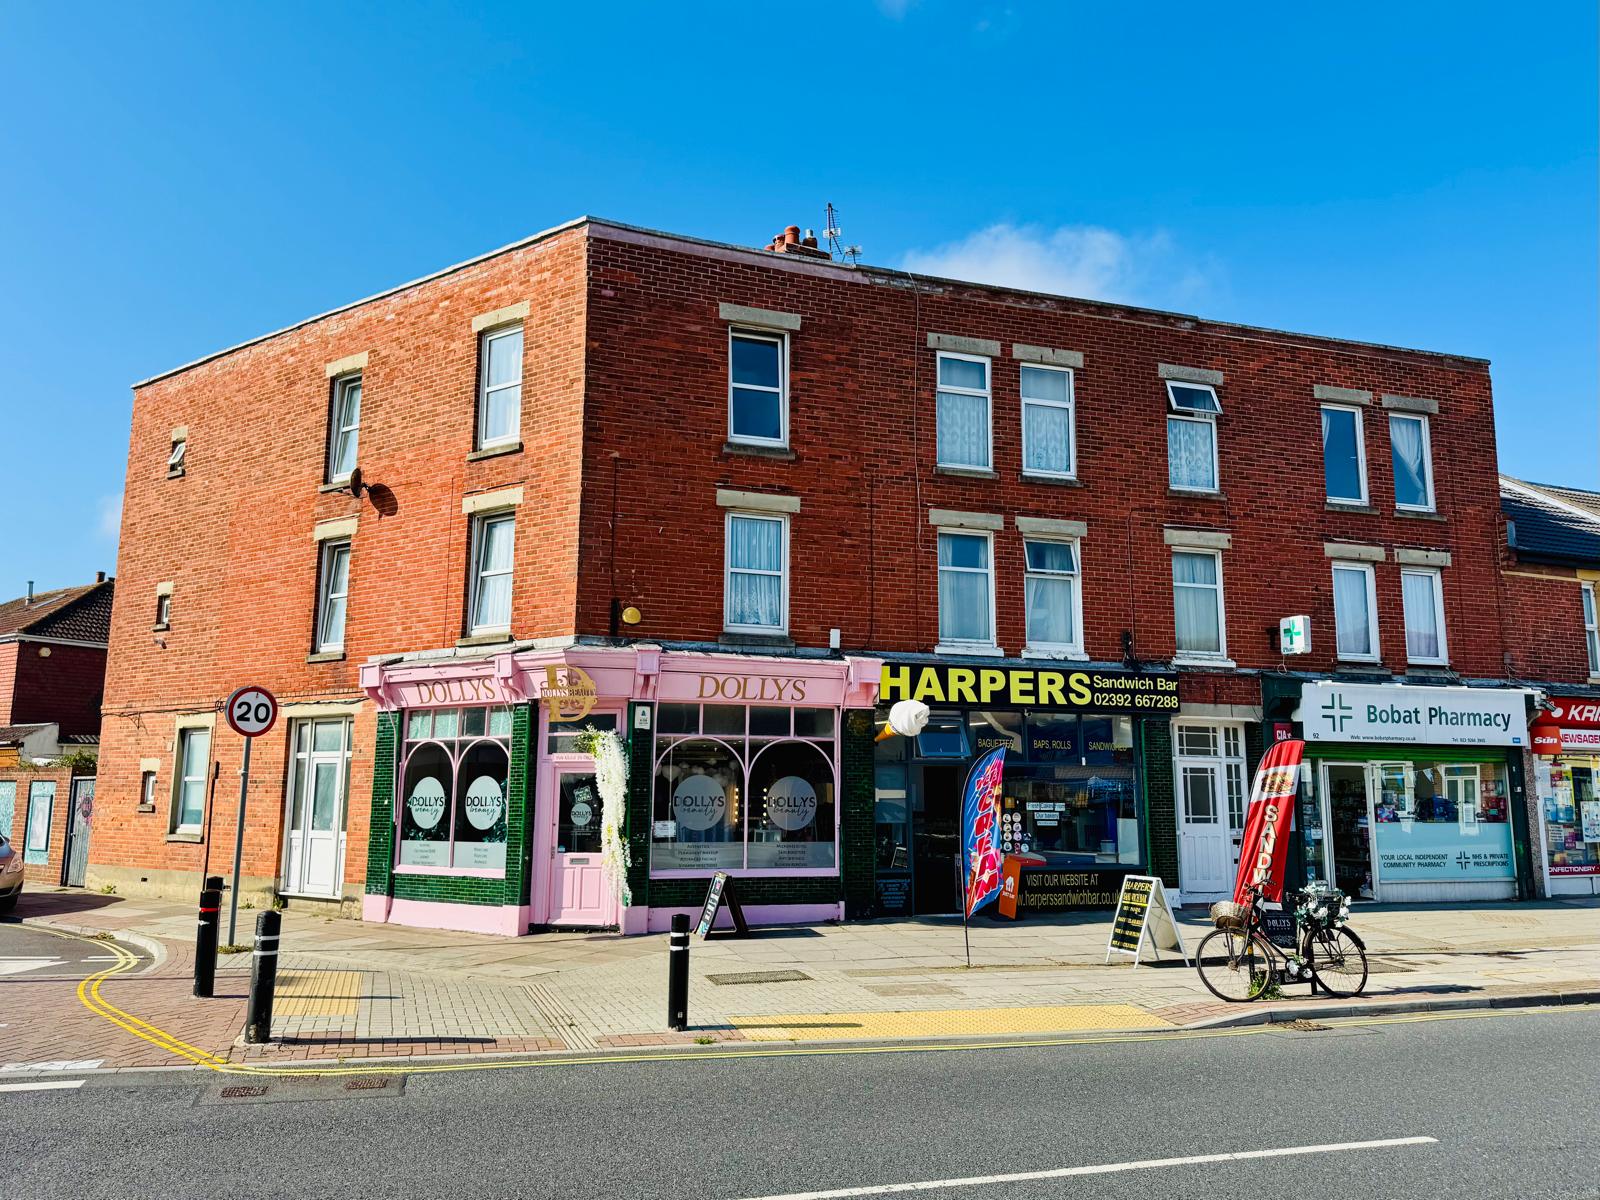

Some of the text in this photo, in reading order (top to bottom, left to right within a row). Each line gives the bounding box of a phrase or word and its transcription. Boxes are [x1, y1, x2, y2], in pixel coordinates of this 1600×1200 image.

[698, 675, 806, 701] DOLLYS
[880, 664, 1092, 705] HARPERS
[1093, 675, 1177, 691] Sandwich Bar
[415, 677, 496, 704] DOLLYS
[1094, 693, 1178, 709] 02392 667288
[236, 701, 270, 723] 20
[1367, 704, 1511, 732] Bobat Pharmacy
[1052, 740, 1071, 750] ROLLS
[1534, 736, 1557, 744] Sun
[412, 796, 444, 807] DOLLYS
[466, 796, 501, 807] DOLLYS
[674, 795, 724, 807] DOLLYS
[767, 796, 816, 807] DOLLYS
[1026, 874, 1099, 886] VISIT OUR WEBSITE AT
[1125, 881, 1153, 892] HARPERS
